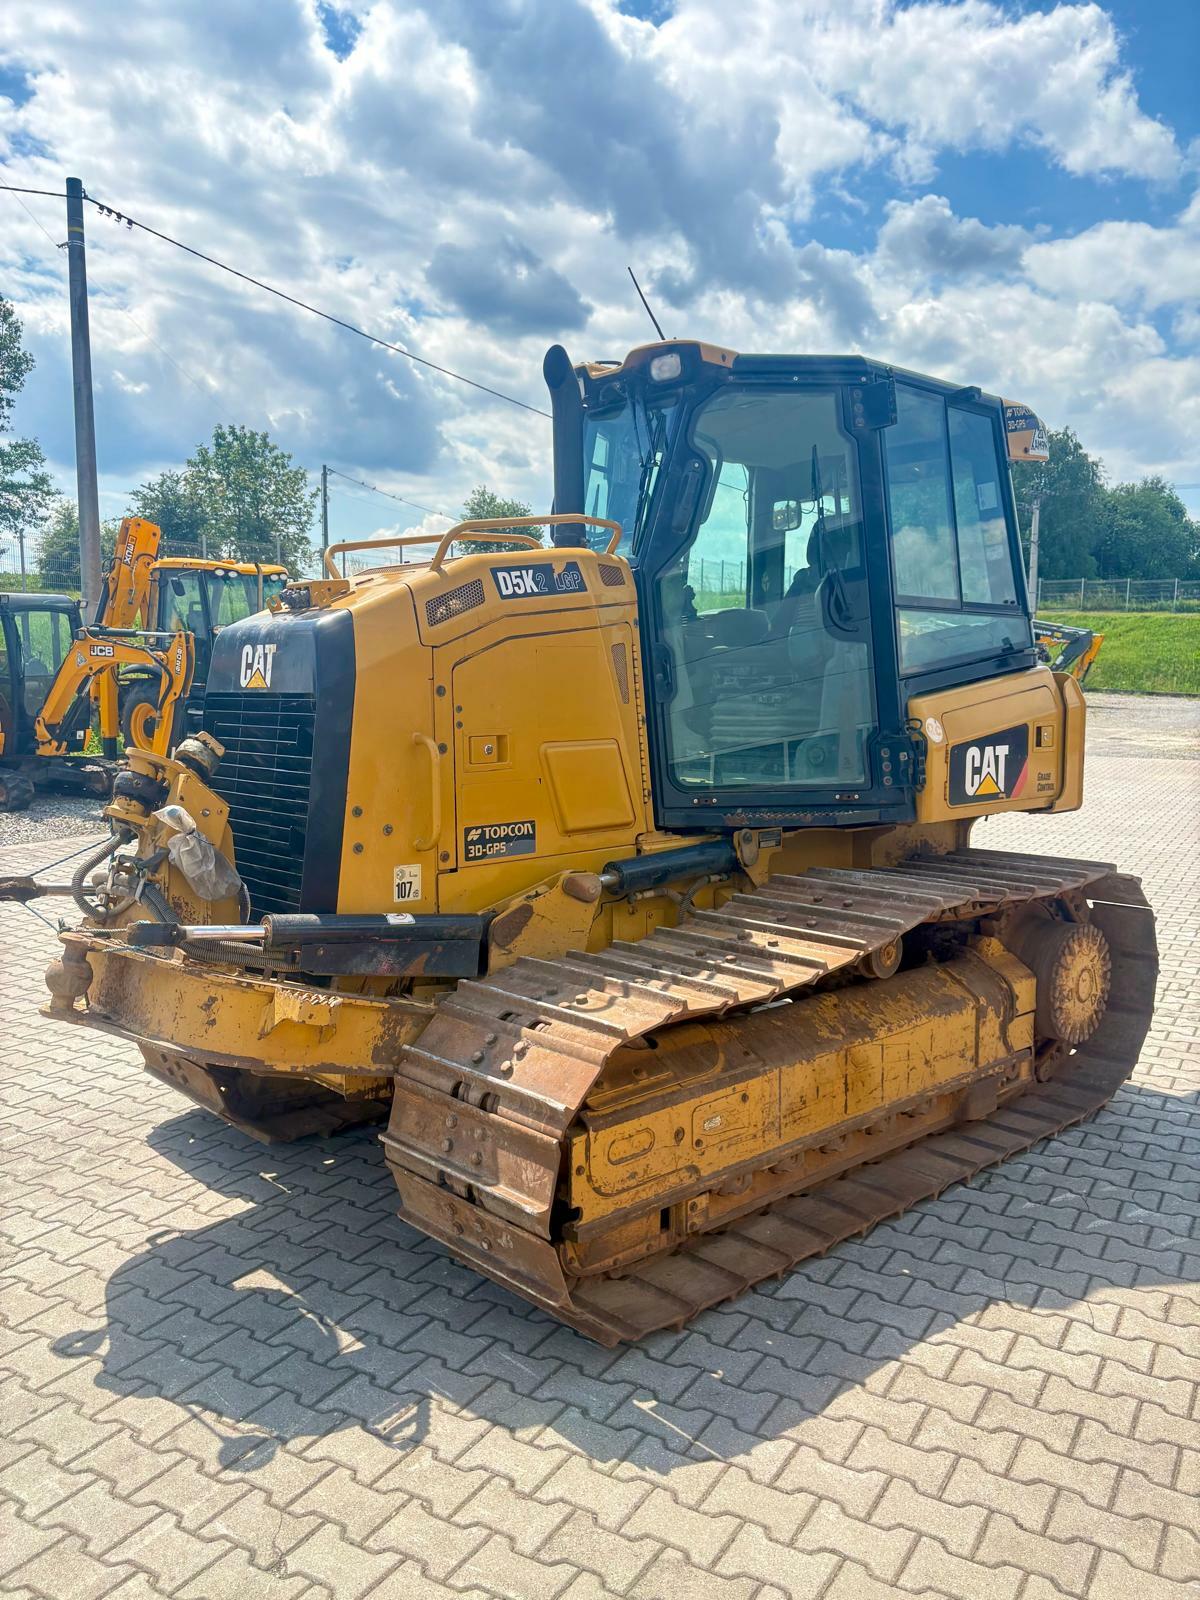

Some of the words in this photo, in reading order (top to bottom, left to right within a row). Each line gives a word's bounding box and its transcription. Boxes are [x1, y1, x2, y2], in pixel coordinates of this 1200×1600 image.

[123, 543, 135, 565] 3CX
[554, 571, 581, 591] LGP
[90, 645, 114, 657] JCB
[239, 643, 277, 688] CAT
[965, 745, 1009, 796] CAT
[483, 823, 533, 840] TOPCON
[468, 842, 506, 858] 3D-GPS
[395, 881, 413, 899] 107
